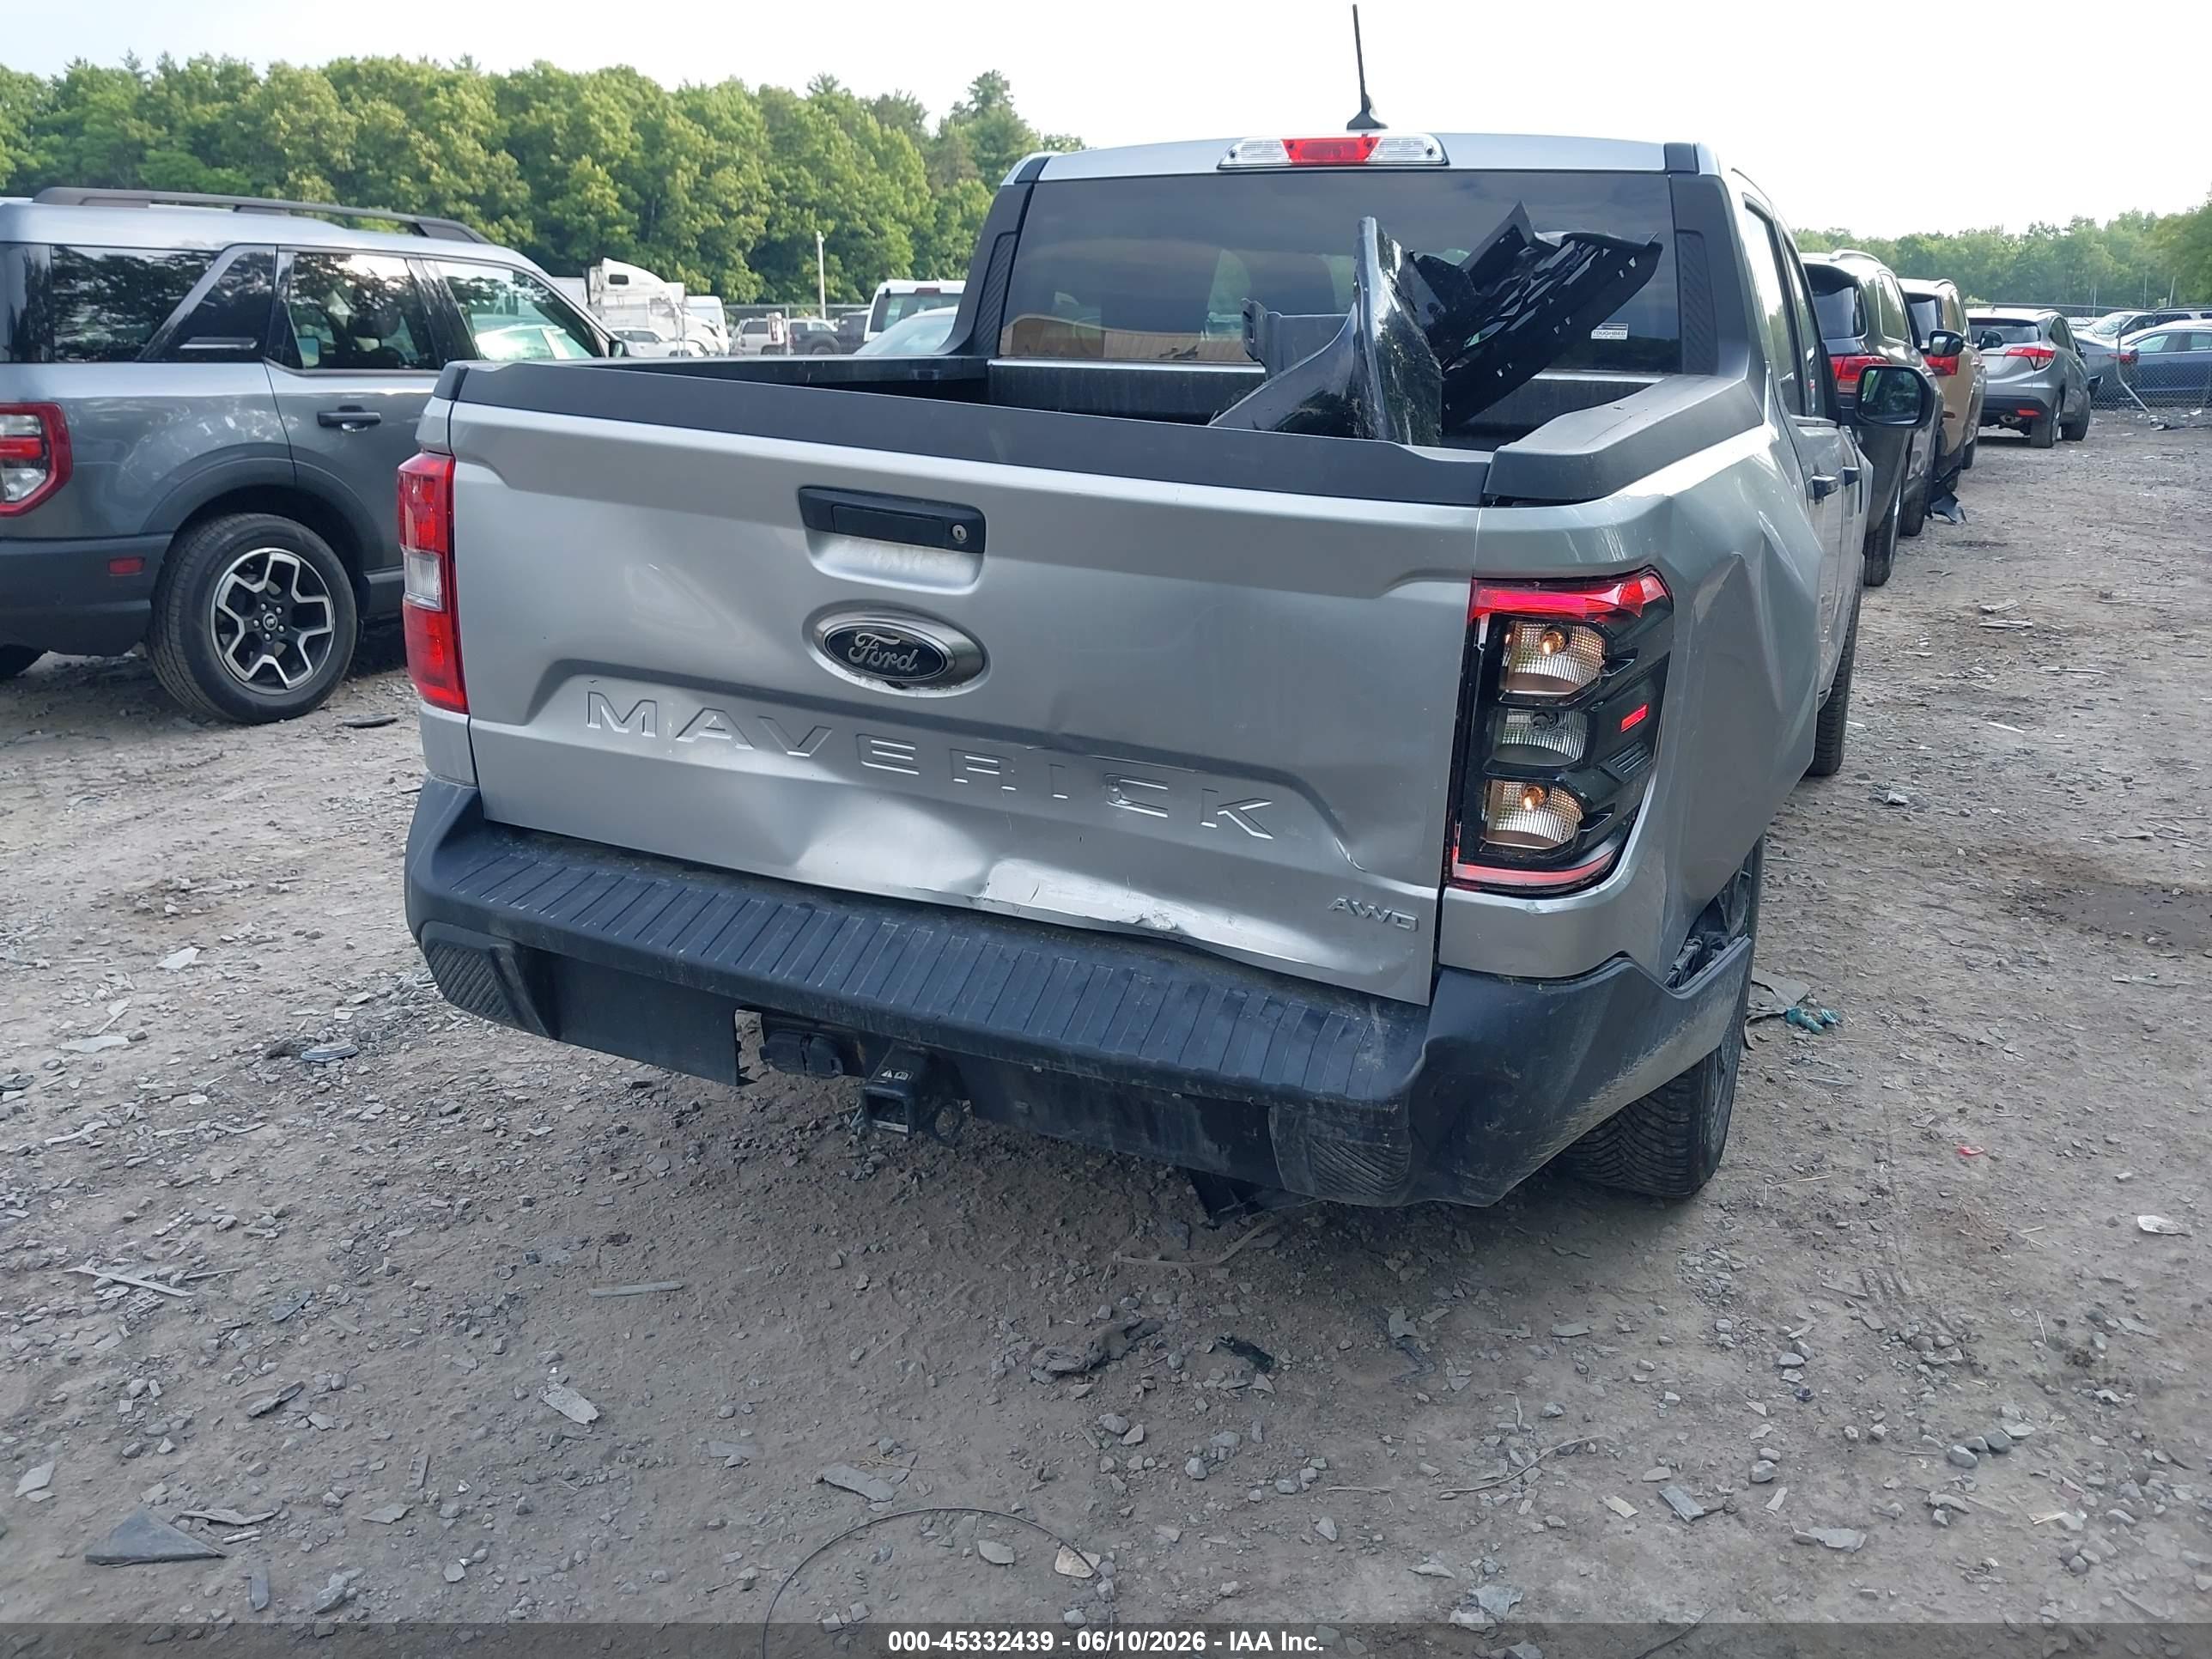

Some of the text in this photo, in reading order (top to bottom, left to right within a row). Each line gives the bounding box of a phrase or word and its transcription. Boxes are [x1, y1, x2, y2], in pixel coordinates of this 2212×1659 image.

[848, 632, 919, 672] Ford
[586, 690, 1274, 840] MAVERICK
[1328, 897, 1419, 932] AWD
